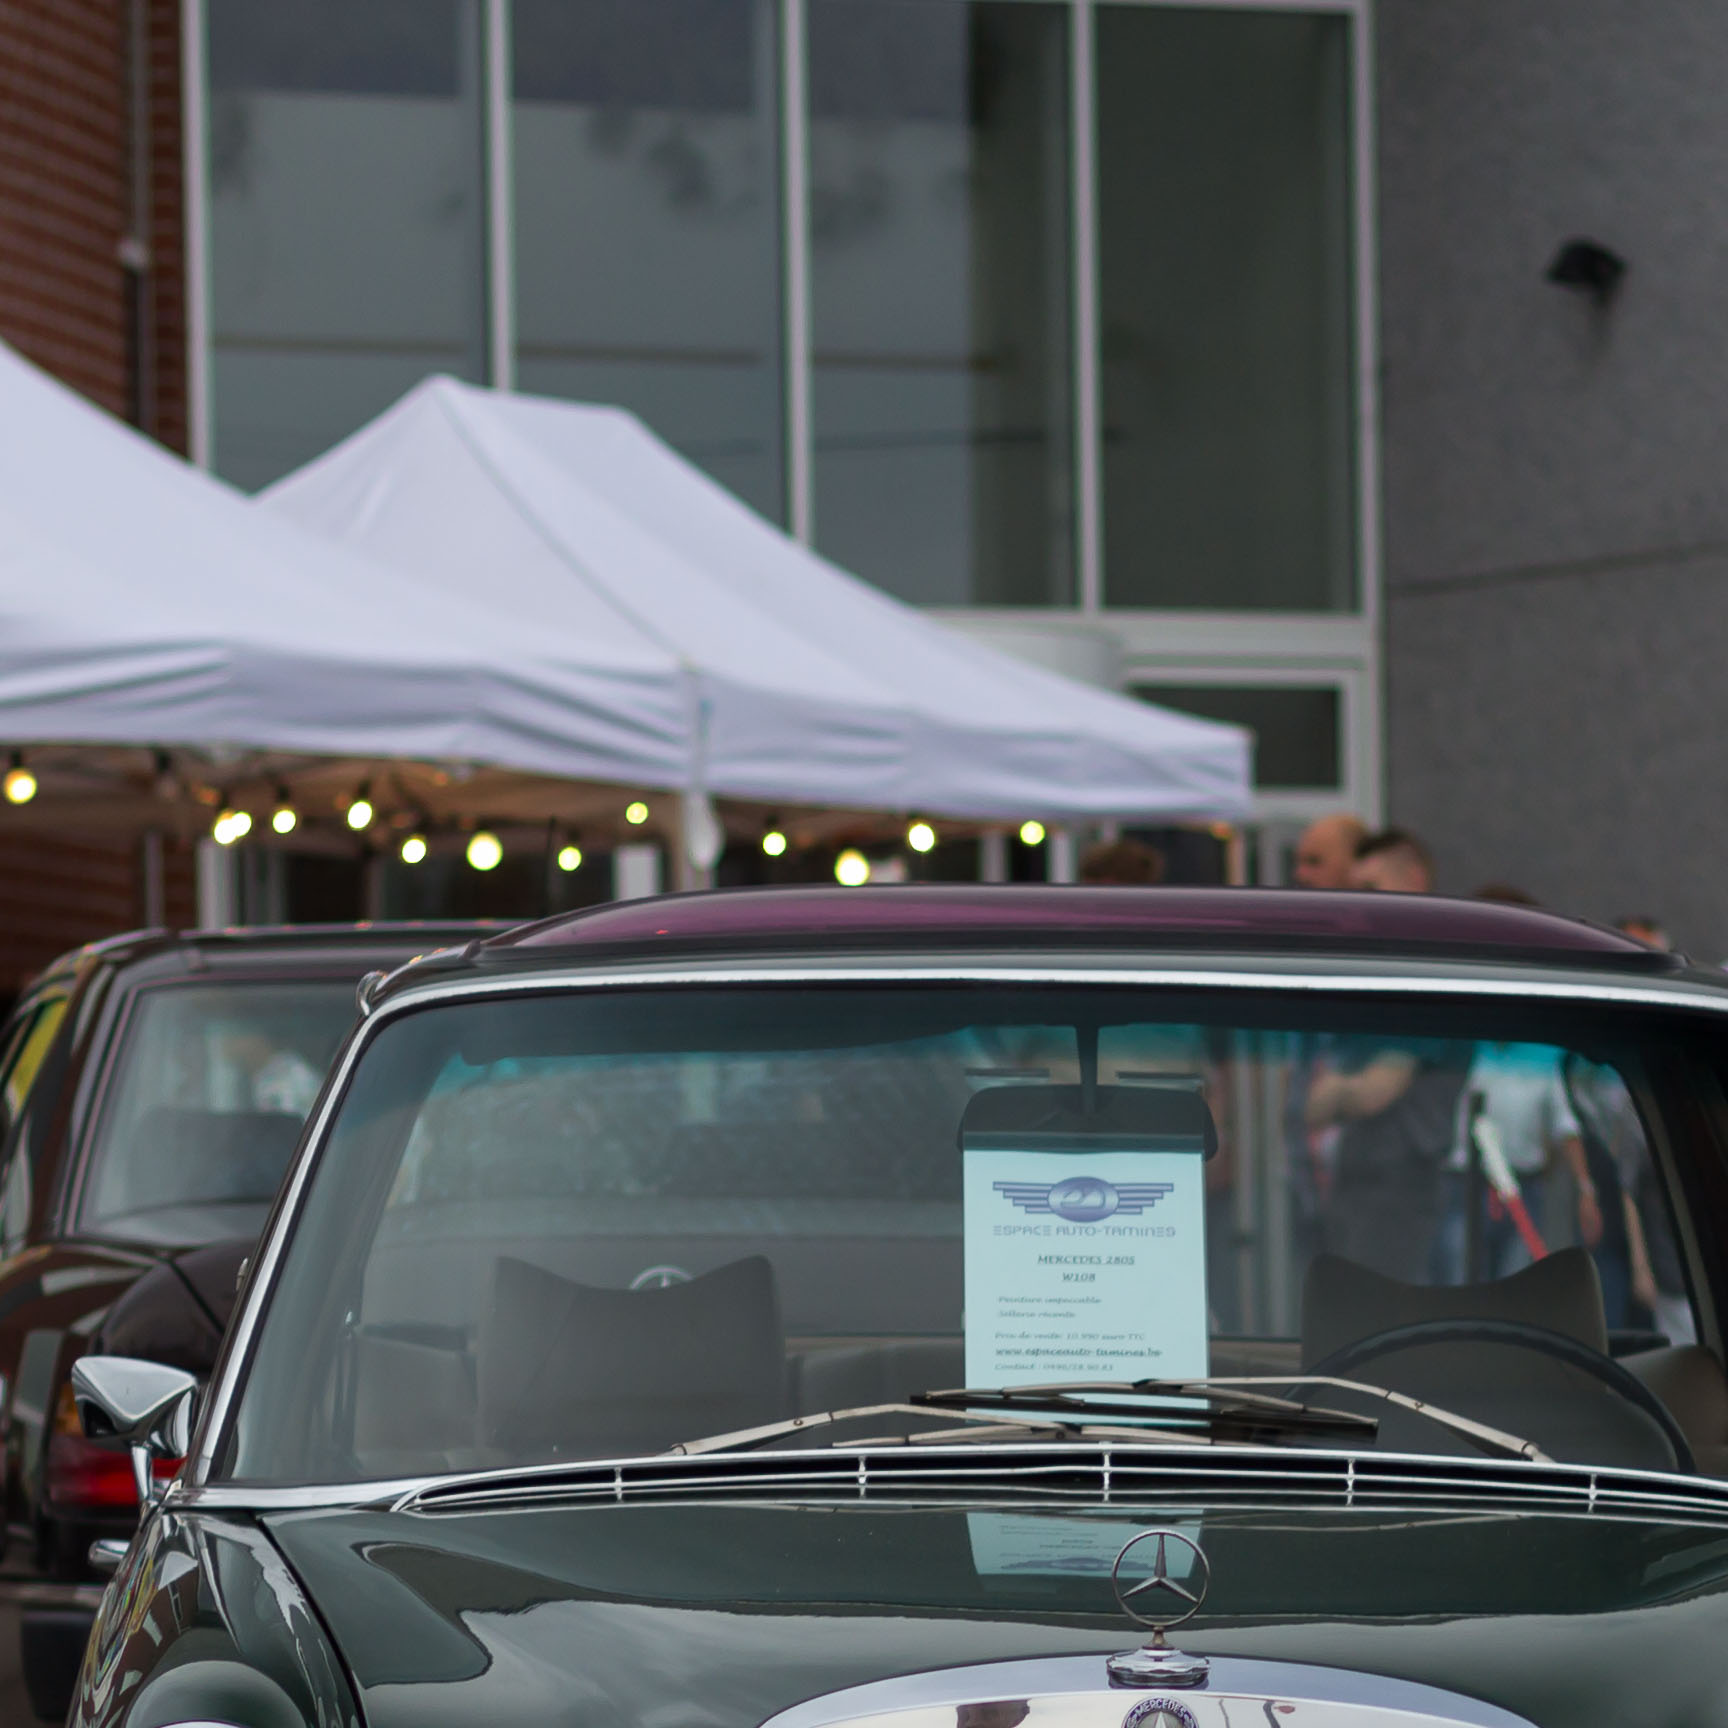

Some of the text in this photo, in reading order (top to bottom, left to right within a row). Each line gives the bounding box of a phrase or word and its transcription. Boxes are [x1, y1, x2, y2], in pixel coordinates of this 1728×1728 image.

[992, 1224, 1177, 1238] ESPACE AUTO-TAMINES
[1037, 1255, 1102, 1265] MERCEDES
[1062, 1272, 1097, 1282] W108
[1134, 1698, 1186, 1718] MERCEDES
